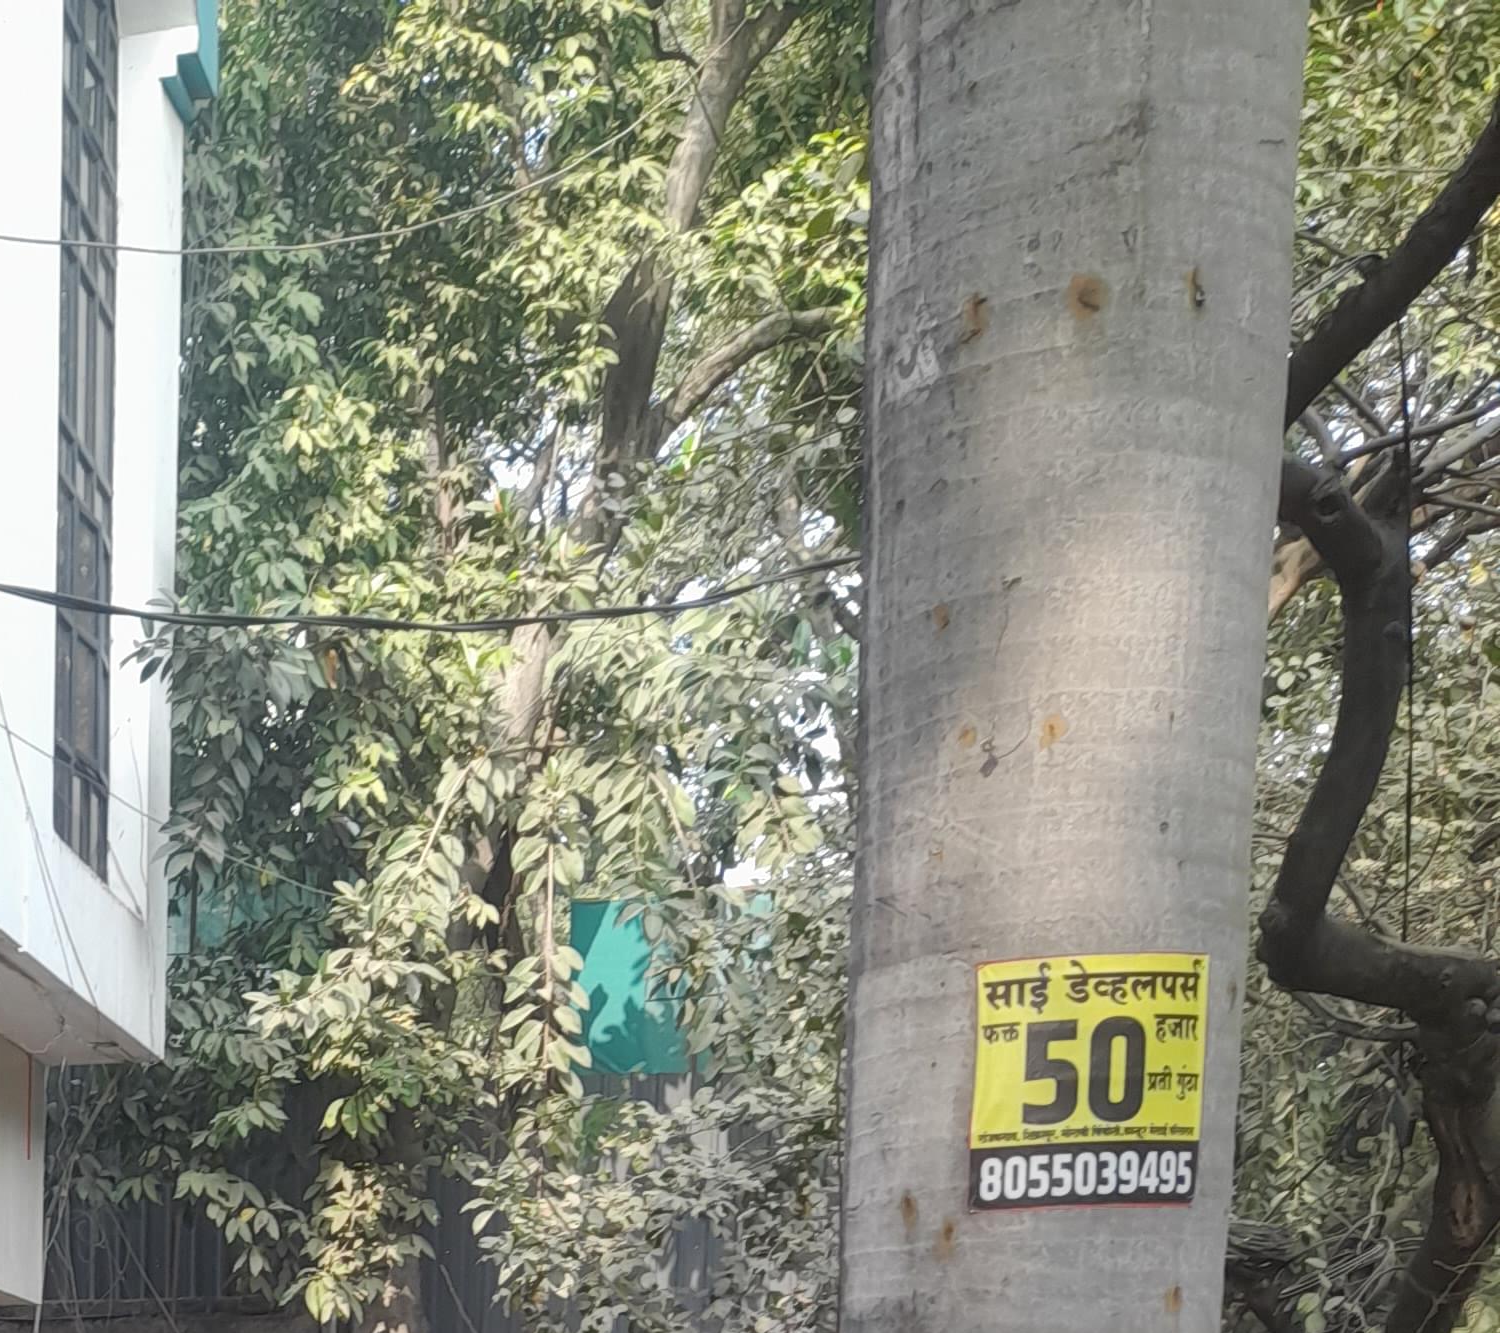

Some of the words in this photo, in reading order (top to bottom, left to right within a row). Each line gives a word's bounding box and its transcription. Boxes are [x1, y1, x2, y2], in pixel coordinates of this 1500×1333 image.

[983, 962, 1051, 1014] साई
[1063, 958, 1203, 1006] डेव्हलपर्स
[982, 1021, 1021, 1045] फक्त
[1021, 1015, 1147, 1125] 50
[1153, 1012, 1199, 1043] हजार
[978, 1150, 1193, 1202] 8055039495
